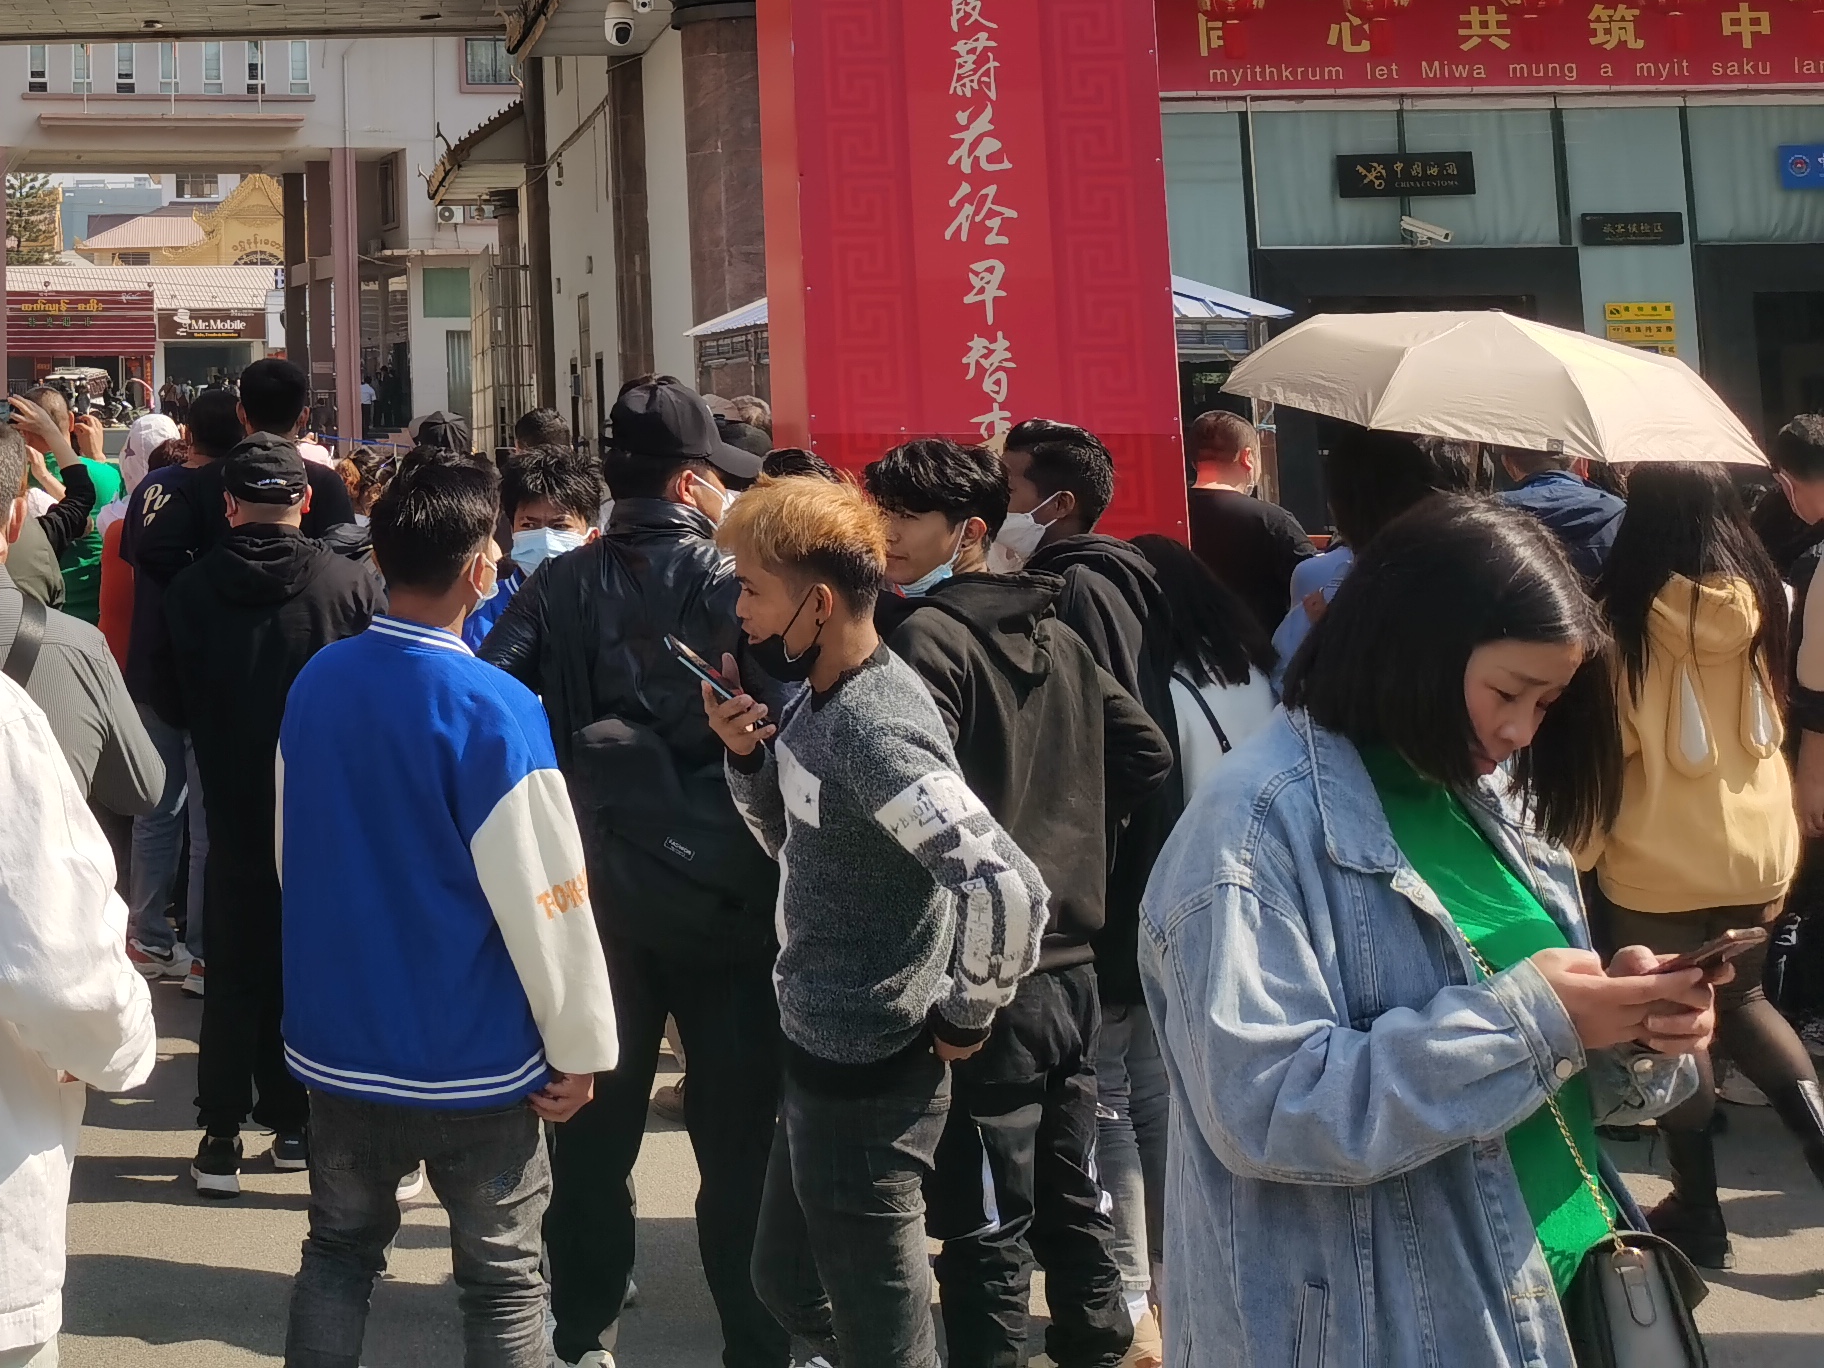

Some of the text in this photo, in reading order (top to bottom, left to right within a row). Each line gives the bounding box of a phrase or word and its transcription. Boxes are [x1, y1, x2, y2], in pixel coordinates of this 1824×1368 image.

[1209, 65, 1344, 86] myithkrum
[1366, 62, 1399, 79] let
[1421, 60, 1486, 79] Miwa
[1509, 61, 1577, 80] mung
[1600, 62, 1613, 76] a
[1636, 58, 1690, 80] myit
[1711, 58, 1771, 76] saku
